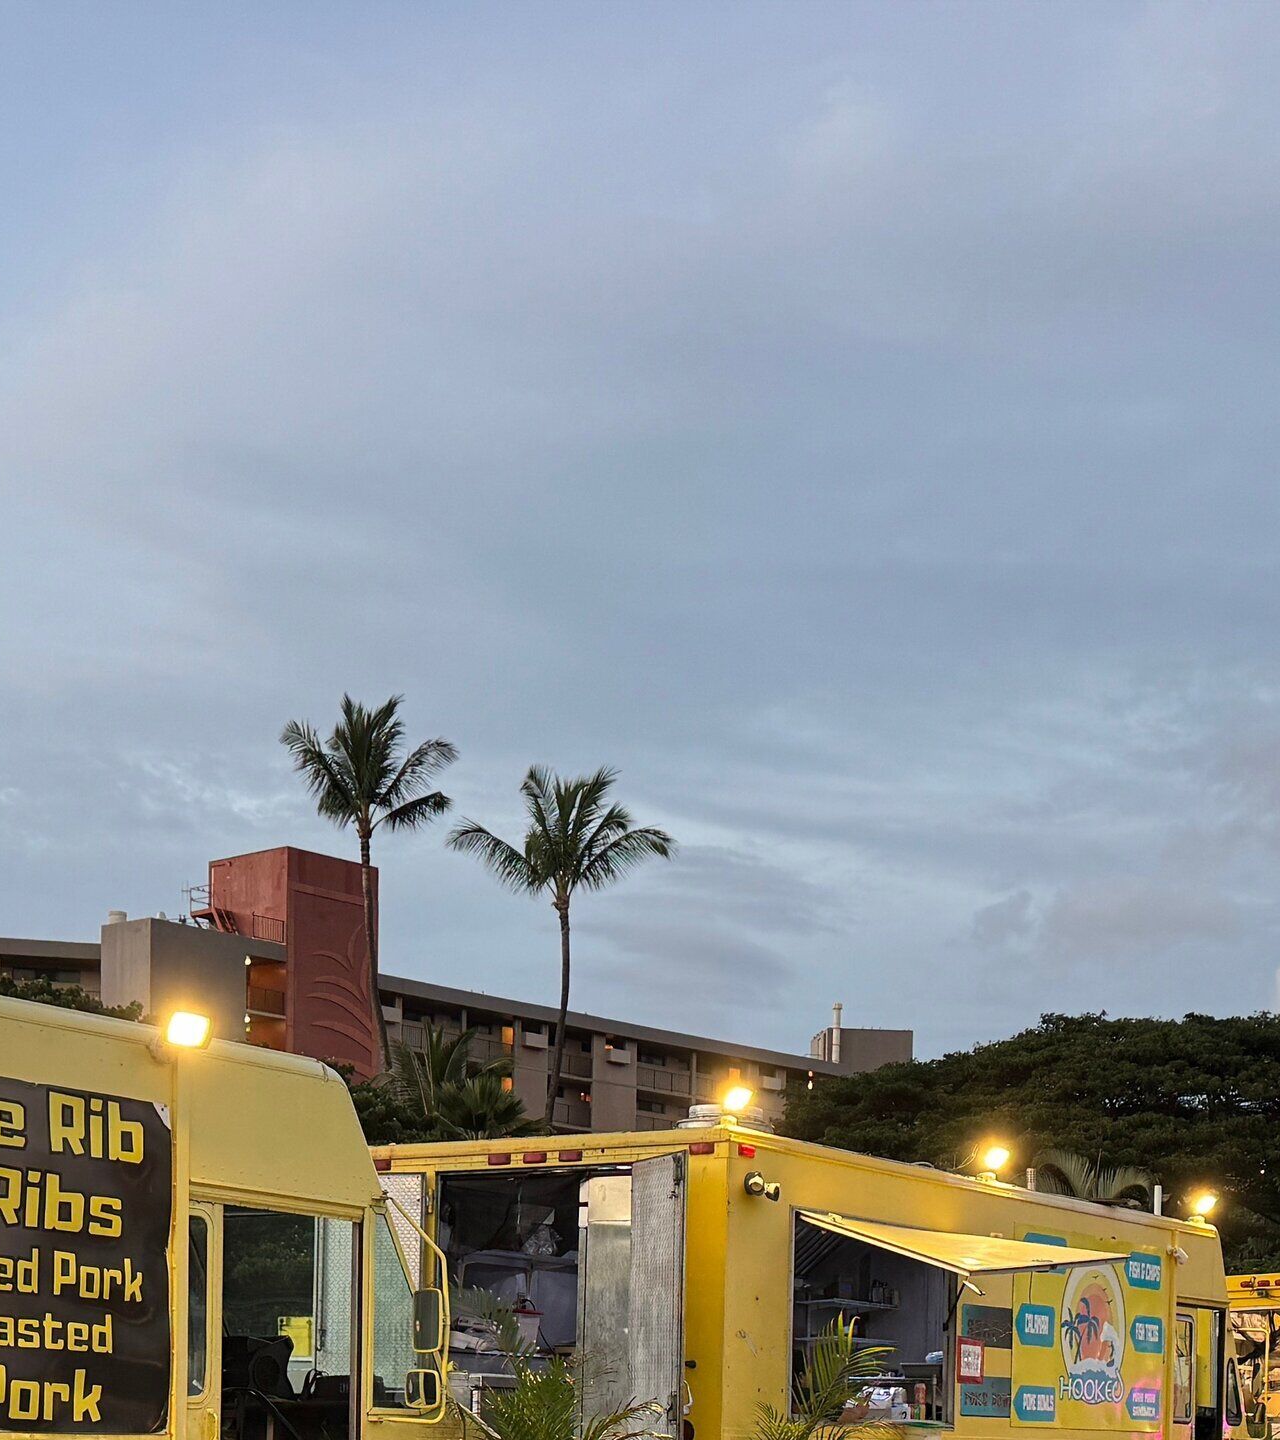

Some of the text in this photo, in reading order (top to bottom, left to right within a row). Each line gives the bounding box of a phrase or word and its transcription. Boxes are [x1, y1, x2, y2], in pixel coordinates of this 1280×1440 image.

[48, 1090, 144, 1164] Rib
[54, 1250, 143, 1302] Pork
[1060, 1370, 1124, 1403] HOOKED
